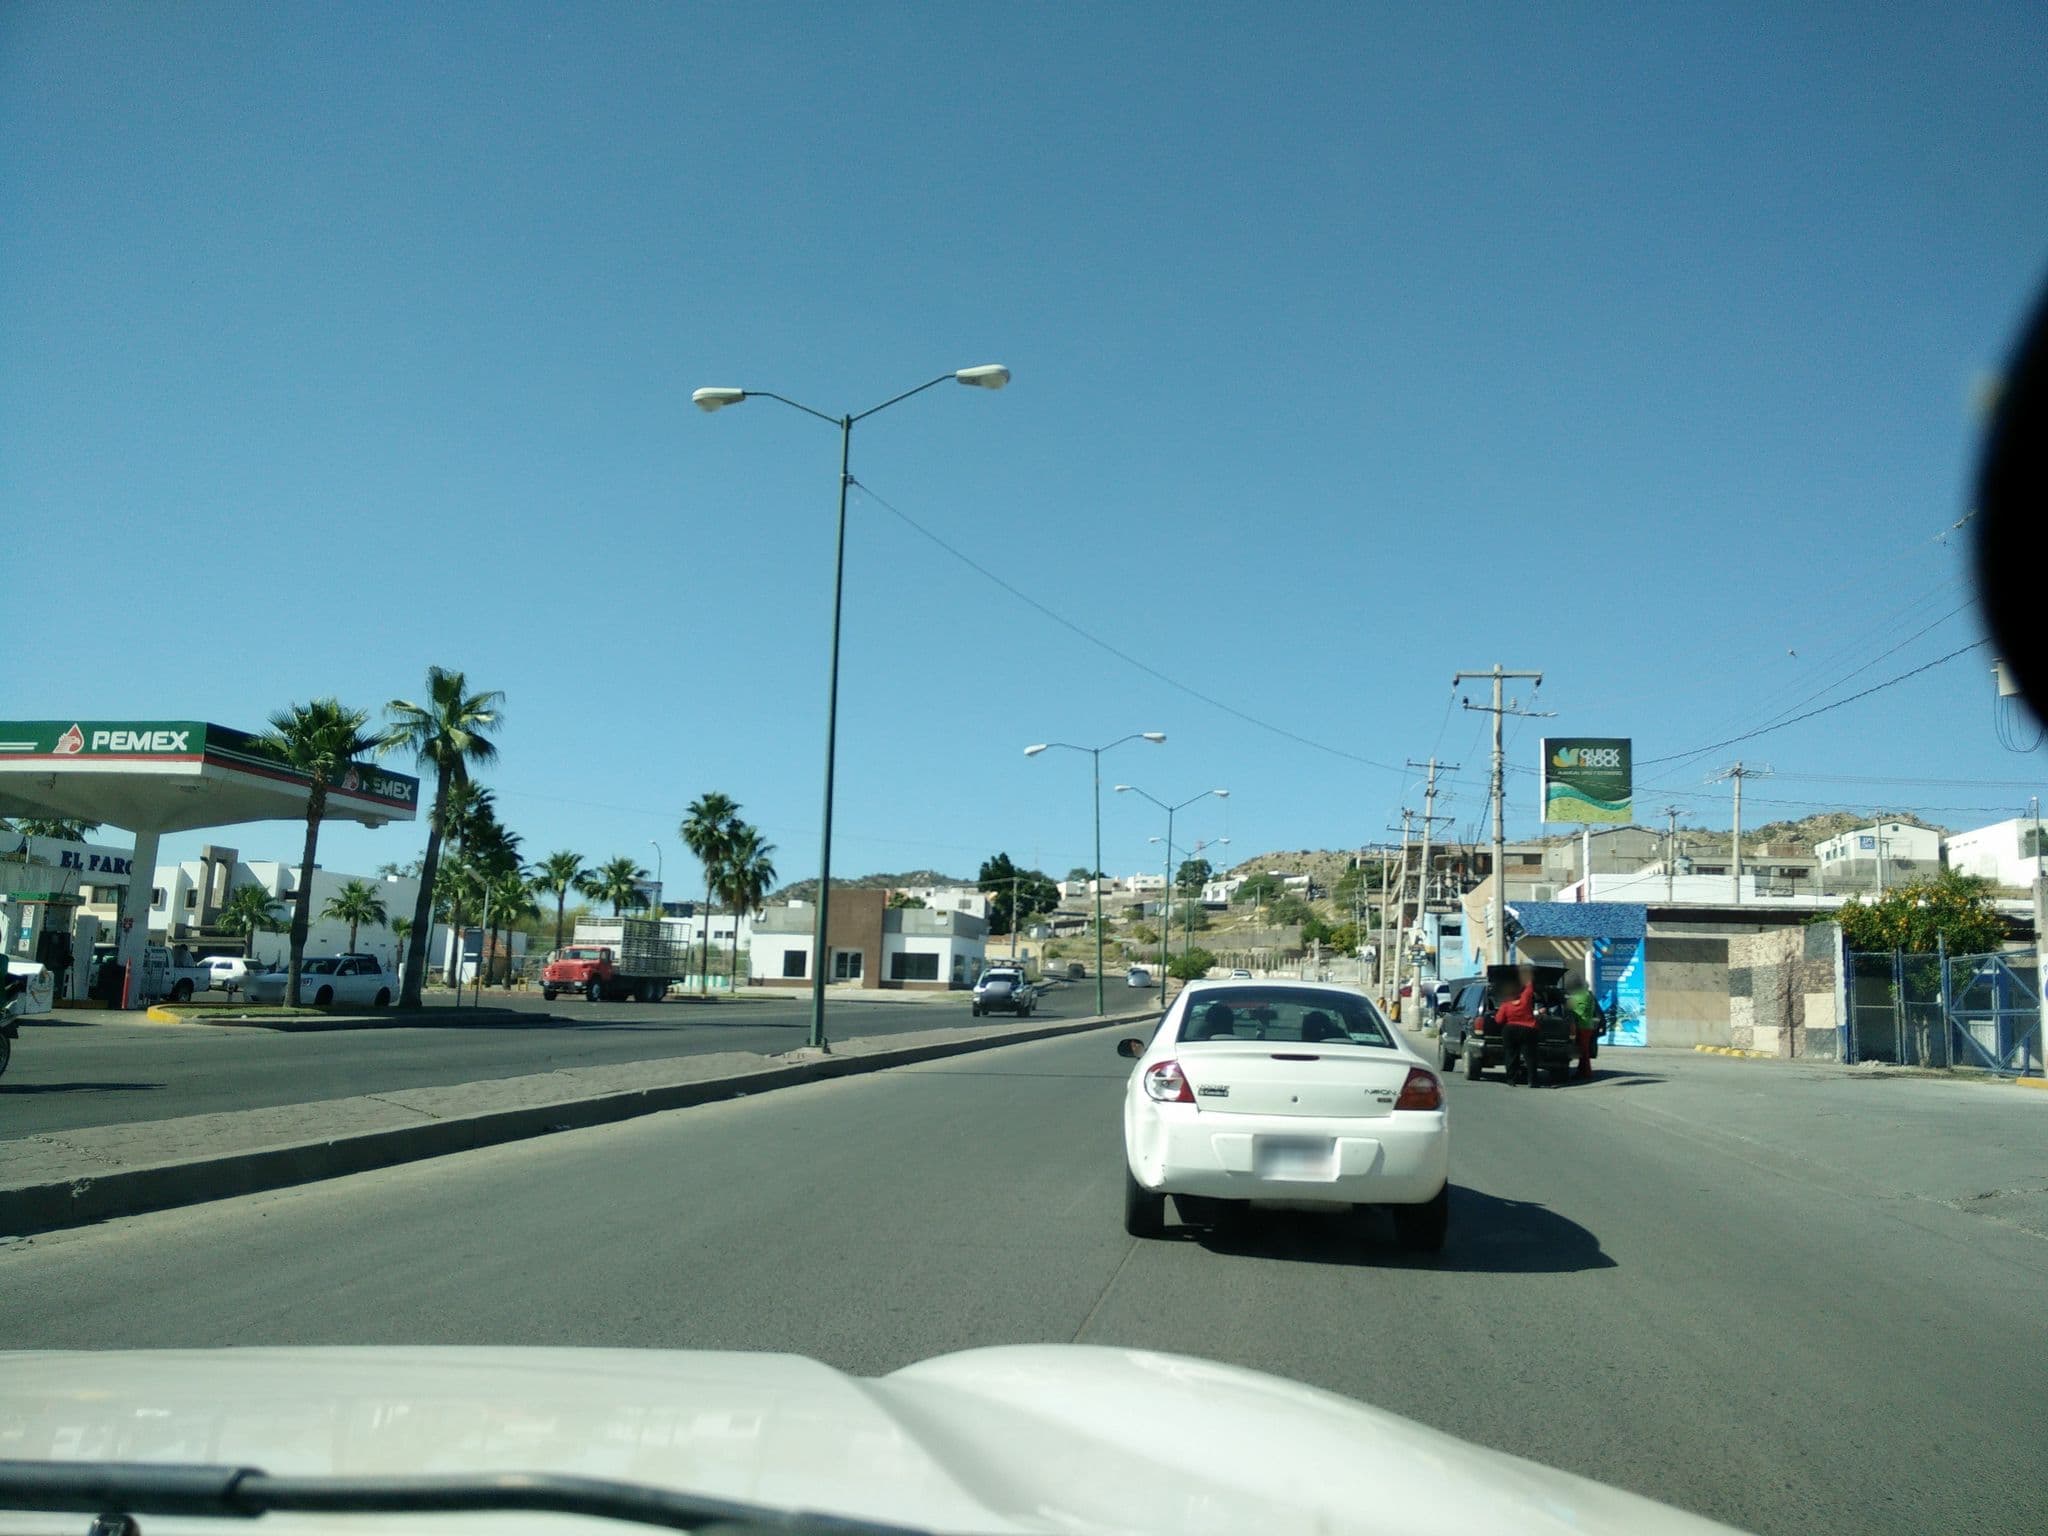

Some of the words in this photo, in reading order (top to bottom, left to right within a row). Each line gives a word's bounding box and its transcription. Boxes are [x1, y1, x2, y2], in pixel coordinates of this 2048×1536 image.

[91, 731, 189, 751] PEMEX
[1580, 748, 1620, 759] QUICK
[1586, 757, 1620, 768] ROCK
[60, 850, 84, 870] EL
